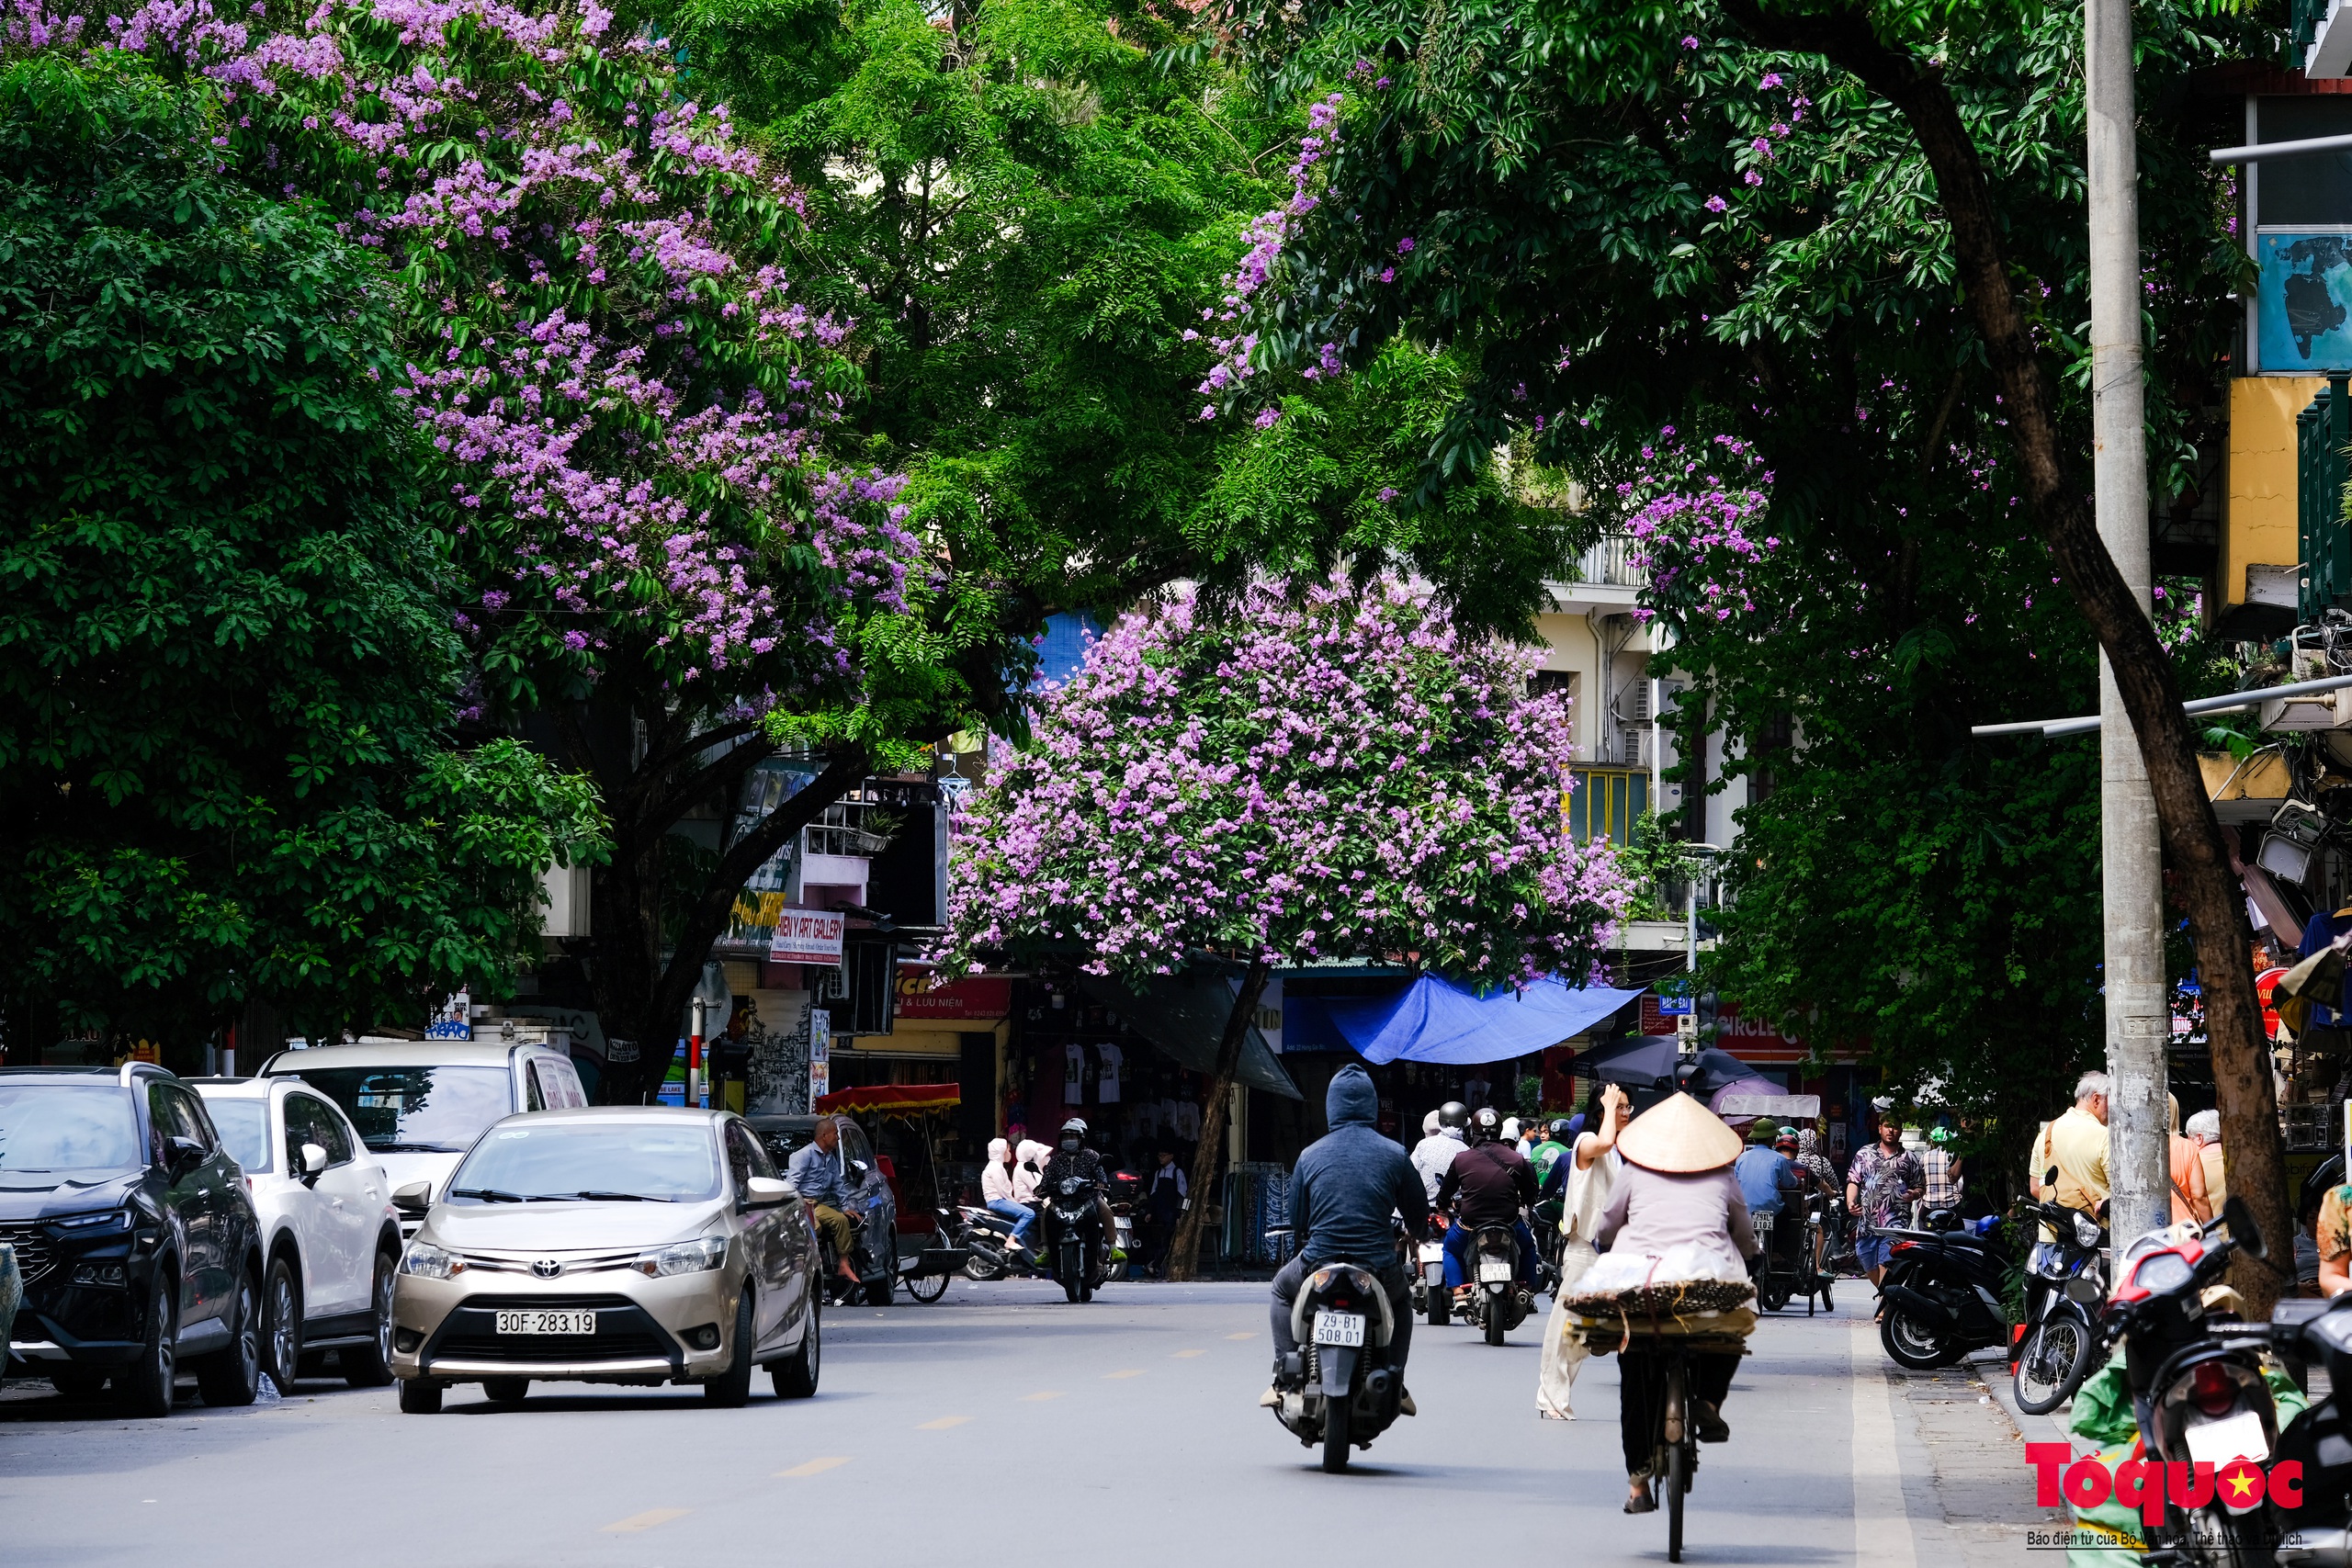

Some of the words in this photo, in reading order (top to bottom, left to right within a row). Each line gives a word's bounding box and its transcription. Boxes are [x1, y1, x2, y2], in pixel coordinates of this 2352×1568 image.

[793, 917, 799, 938] Y
[799, 918, 812, 938] ART
[814, 919, 843, 941] GALLERY
[916, 998, 935, 1007] LƯU
[938, 996, 963, 1010] NIỆM
[840, 1037, 850, 1046] 24
[499, 1314, 593, 1332] 30F-283.19
[1324, 1314, 1357, 1330] 29-B1
[1318, 1329, 1361, 1344] 508.01
